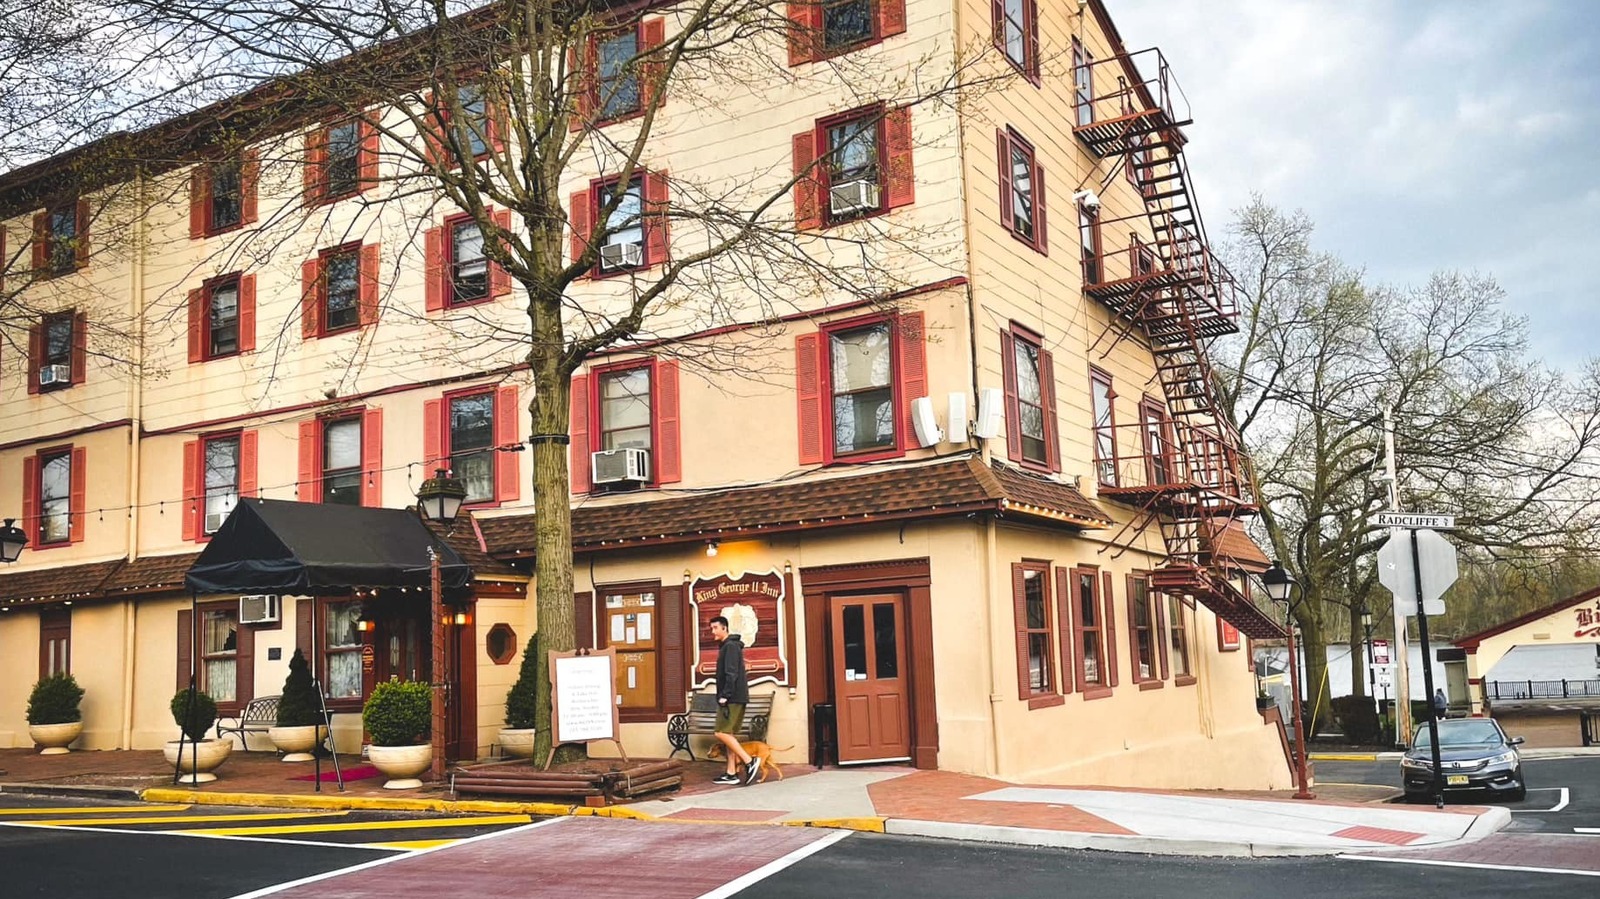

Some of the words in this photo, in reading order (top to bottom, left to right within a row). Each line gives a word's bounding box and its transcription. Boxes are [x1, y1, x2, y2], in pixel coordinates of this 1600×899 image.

[1378, 514, 1439, 527] RADCLIFFE
[694, 587, 718, 604] King
[718, 582, 750, 595] George
[760, 581, 779, 599] Inn
